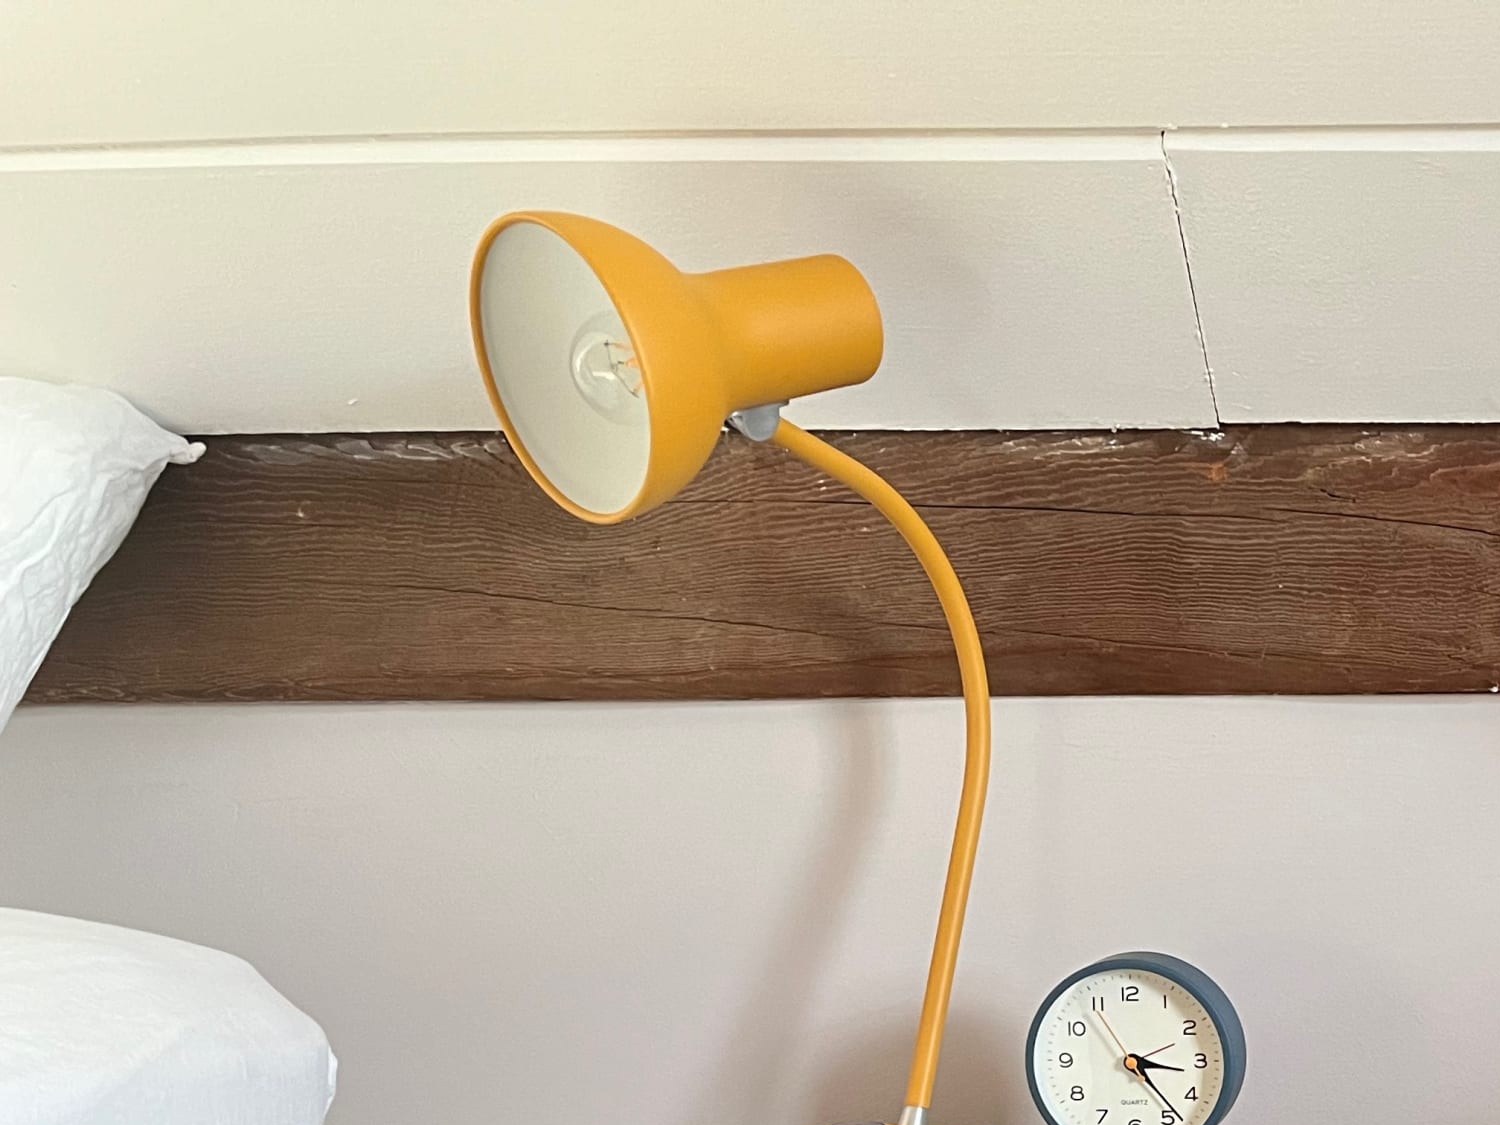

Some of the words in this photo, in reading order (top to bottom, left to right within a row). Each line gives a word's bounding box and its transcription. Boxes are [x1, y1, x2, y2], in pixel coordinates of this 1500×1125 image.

[1121, 986, 1140, 1002] 12
[1163, 994, 1167, 1009] 1
[1092, 996, 1104, 1012] 11
[1067, 1021, 1087, 1036] 10
[1182, 1019, 1197, 1036] 2
[1058, 1052, 1074, 1068] 9
[1193, 1053, 1208, 1069] 3
[1069, 1085, 1085, 1101] 8
[1183, 1086, 1199, 1102] 4
[1096, 1109, 1109, 1125] 7
[1160, 1109, 1176, 1125] 5
